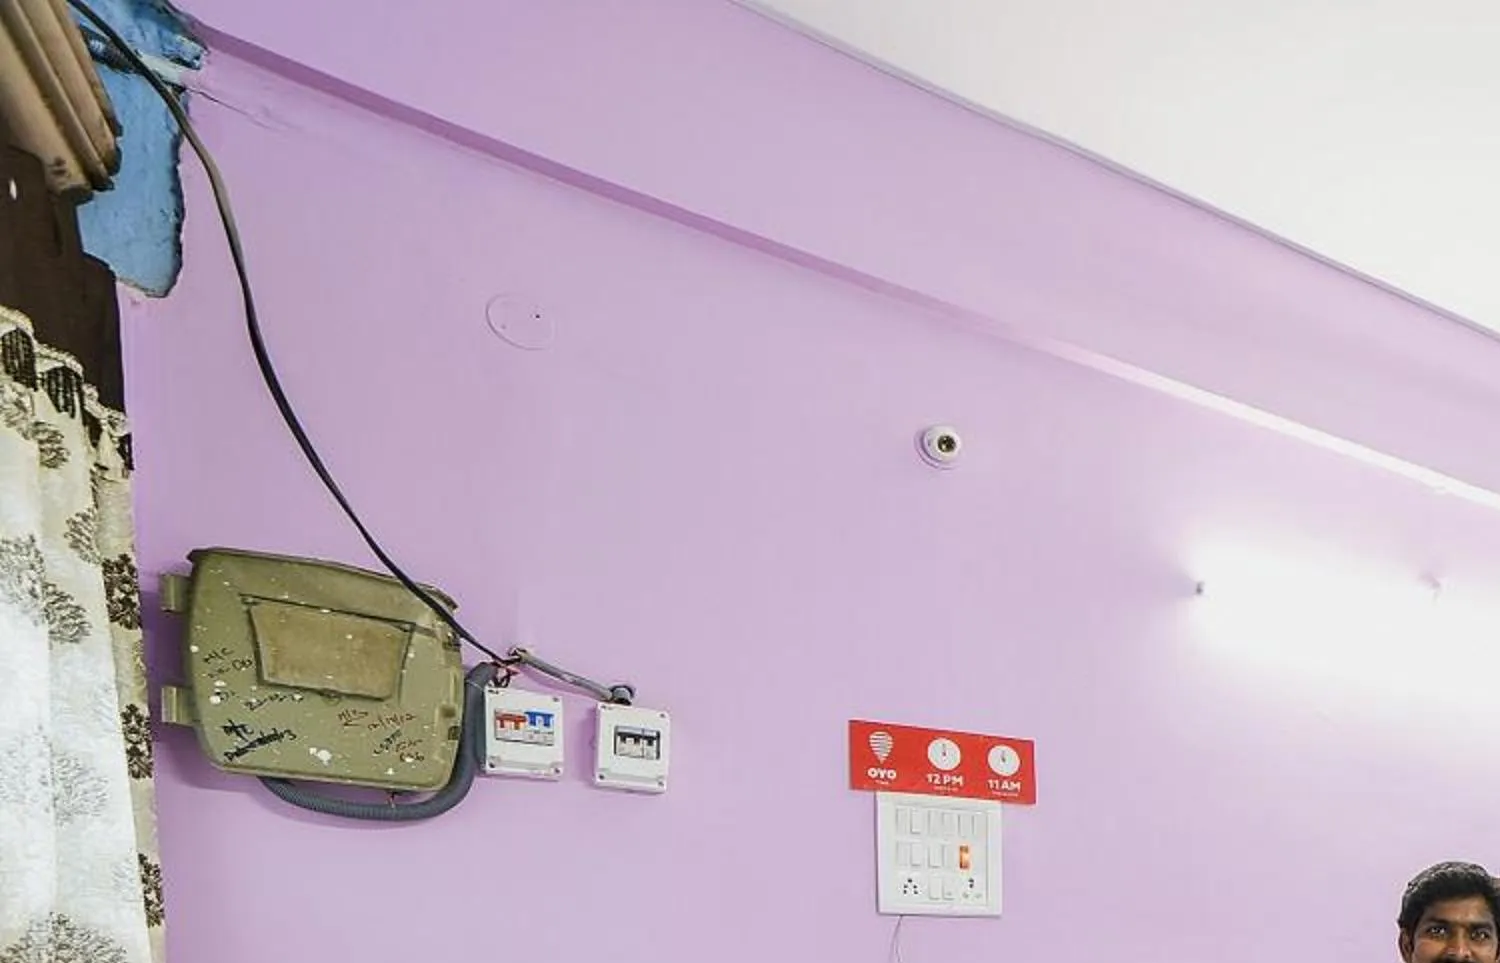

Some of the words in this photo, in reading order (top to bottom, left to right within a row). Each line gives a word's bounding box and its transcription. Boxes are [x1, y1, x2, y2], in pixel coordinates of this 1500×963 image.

[867, 767, 897, 779] OYO
[926, 773, 940, 785] 12
[943, 774, 963, 786] PM
[987, 779, 1000, 790] 11
[1001, 780, 1021, 791] AM
